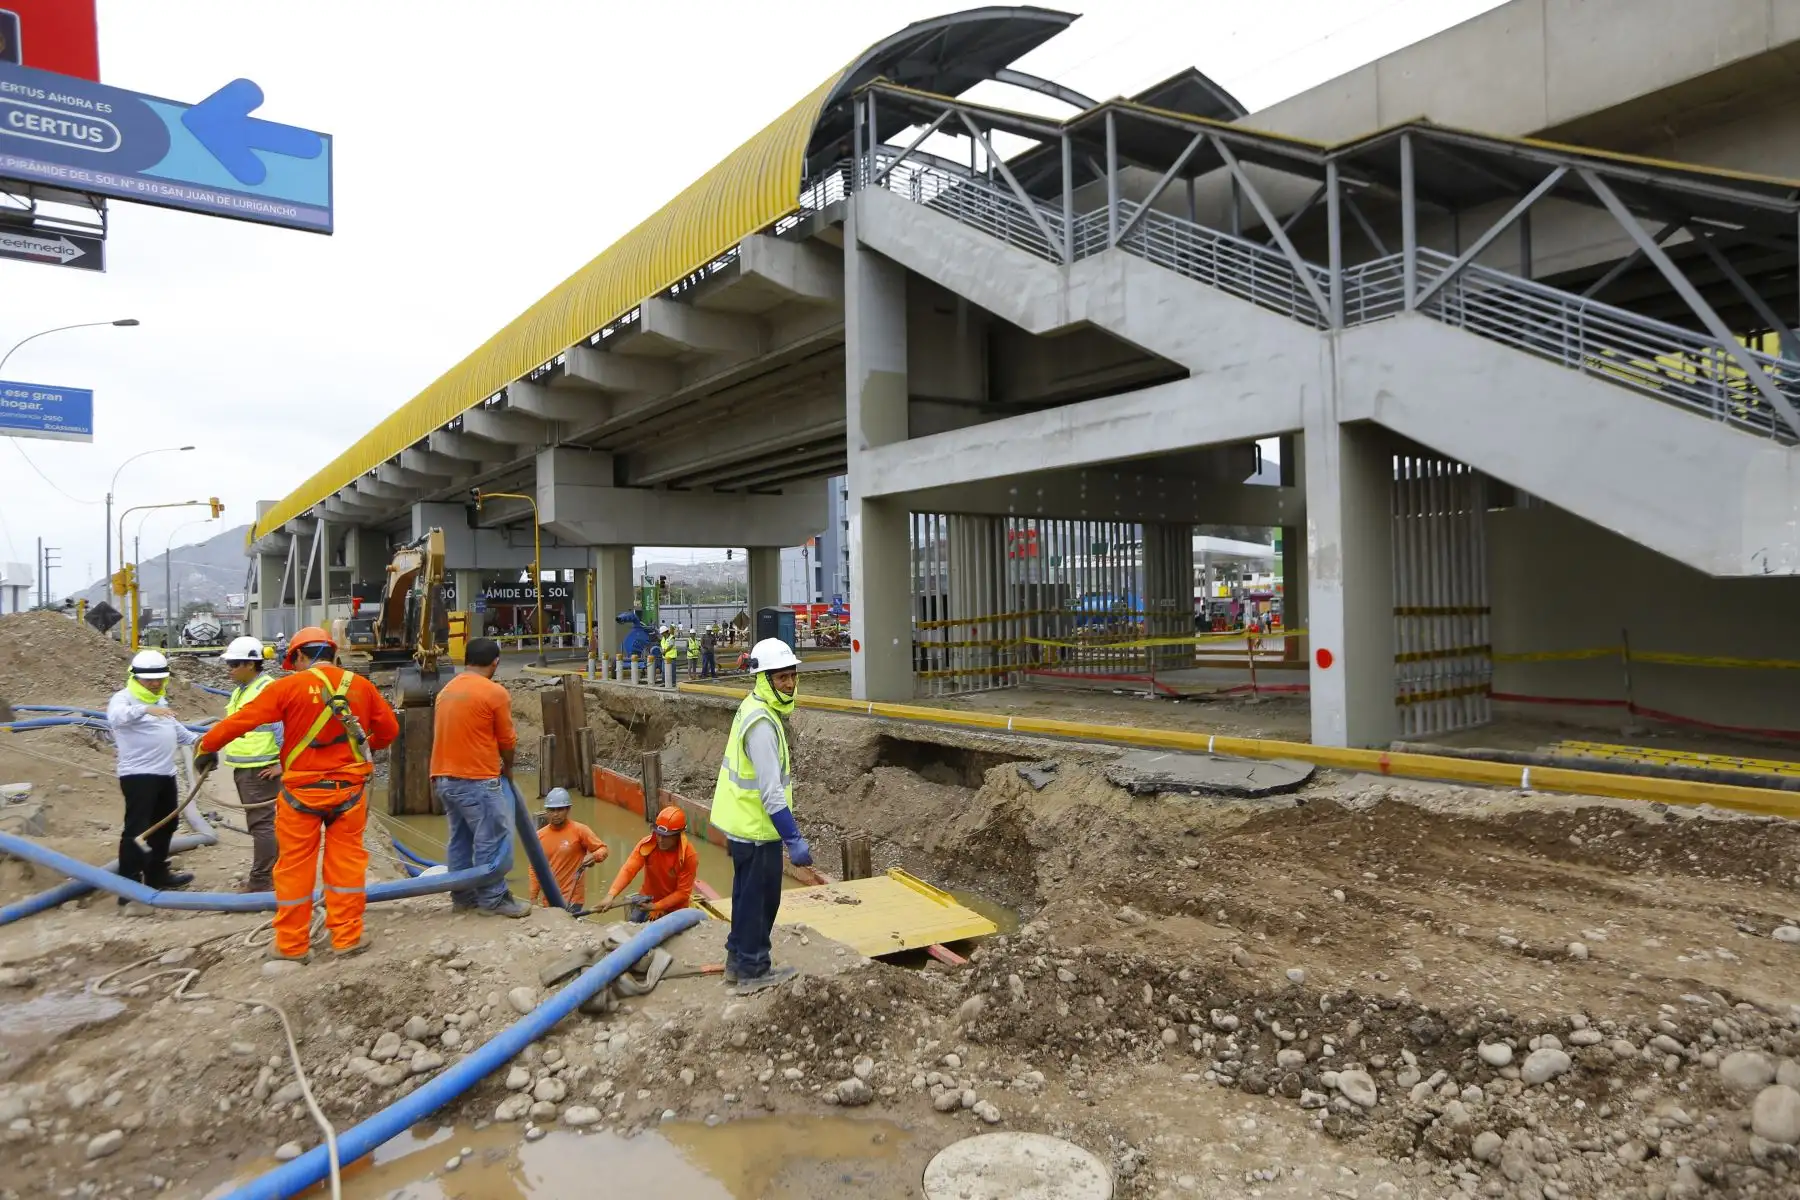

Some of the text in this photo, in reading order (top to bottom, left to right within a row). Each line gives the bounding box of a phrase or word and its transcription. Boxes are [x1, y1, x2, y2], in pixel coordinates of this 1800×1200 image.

[0, 81, 112, 113] ERTUS AHORA ES
[8, 111, 104, 143] CERTUS
[7, 158, 67, 177] PIRÁMIDE
[69, 169, 93, 181] DEL
[96, 174, 118, 187] SOL
[138, 182, 158, 193] 810
[161, 186, 183, 198] SAN
[186, 191, 215, 203] JUAN
[217, 195, 231, 206] DE
[233, 200, 297, 217] LURIGANCHO
[0, 237, 75, 256] eetmedia
[1, 398, 43, 410] hogar.
[5, 389, 63, 402] ese gran
[482, 587, 521, 599] ÁMIDE
[548, 588, 568, 597] SOL
